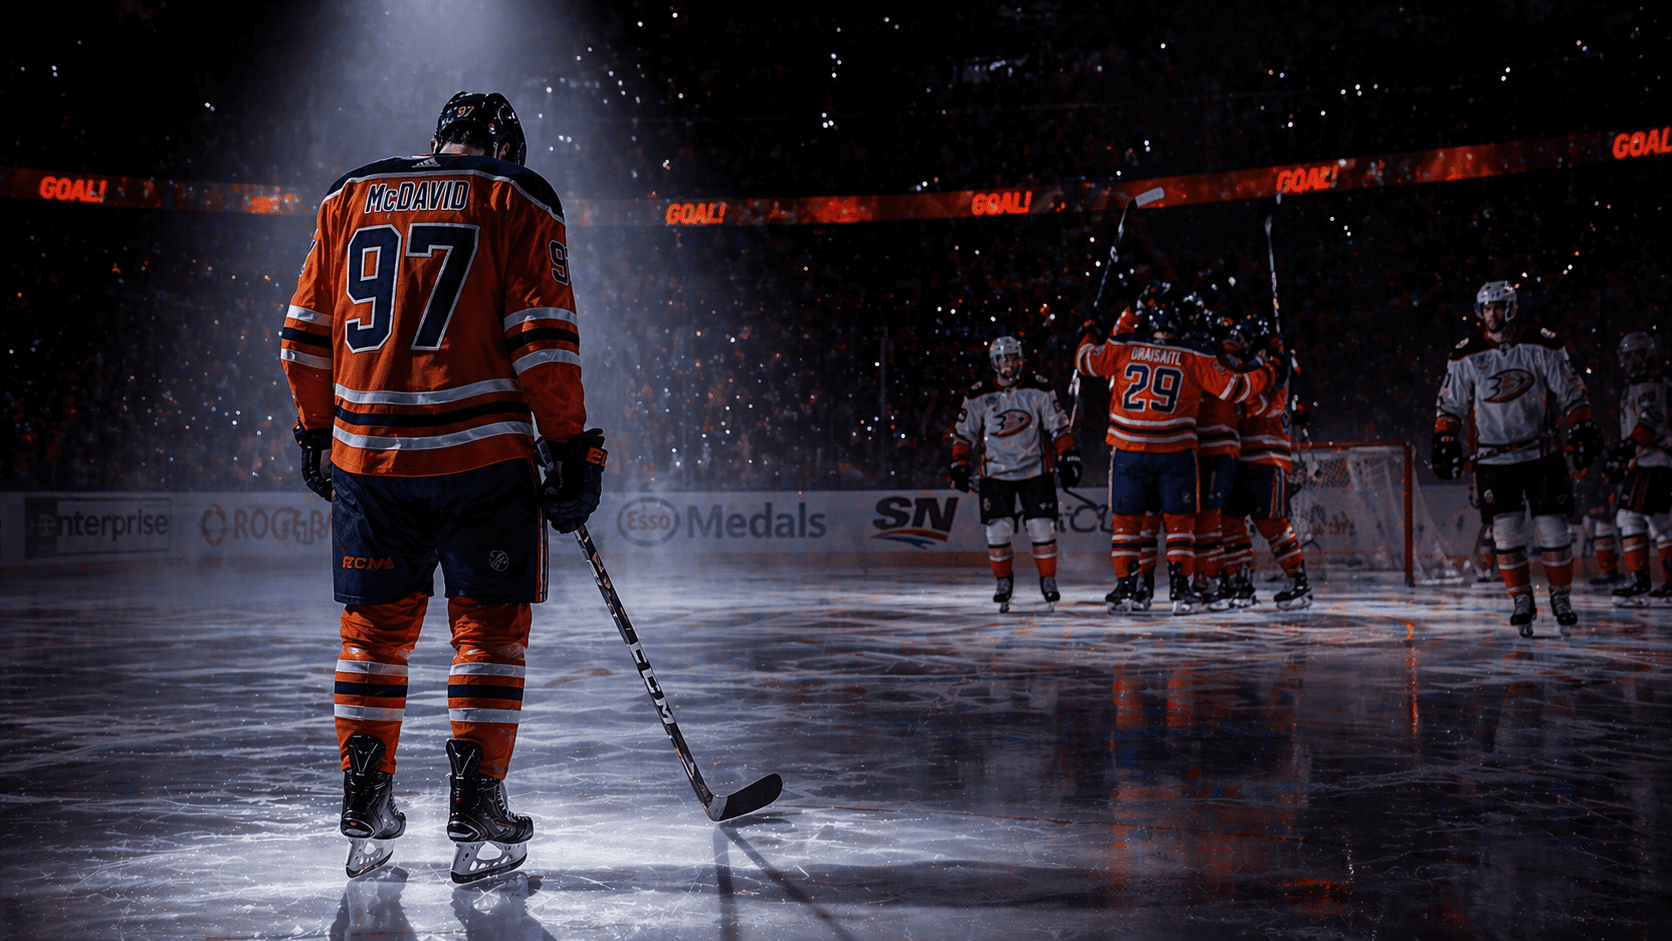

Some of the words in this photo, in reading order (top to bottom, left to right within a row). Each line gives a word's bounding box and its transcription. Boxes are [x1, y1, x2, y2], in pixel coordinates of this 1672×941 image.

[457, 106, 475, 118] 97
[39, 176, 108, 203] GOAL!
[1276, 165, 1339, 193] GOAL!
[363, 179, 471, 214] McDAVID
[665, 201, 727, 225] GOAL!
[971, 191, 1033, 216] GOAL!
[549, 239, 569, 286] 9
[345, 222, 480, 354] 97
[1130, 346, 1183, 367] DRAISAITL
[1121, 361, 1186, 415] 29
[37, 508, 169, 542] enterprise
[626, 510, 671, 531] Esso
[687, 502, 827, 539] Medals
[872, 496, 960, 532] SN
